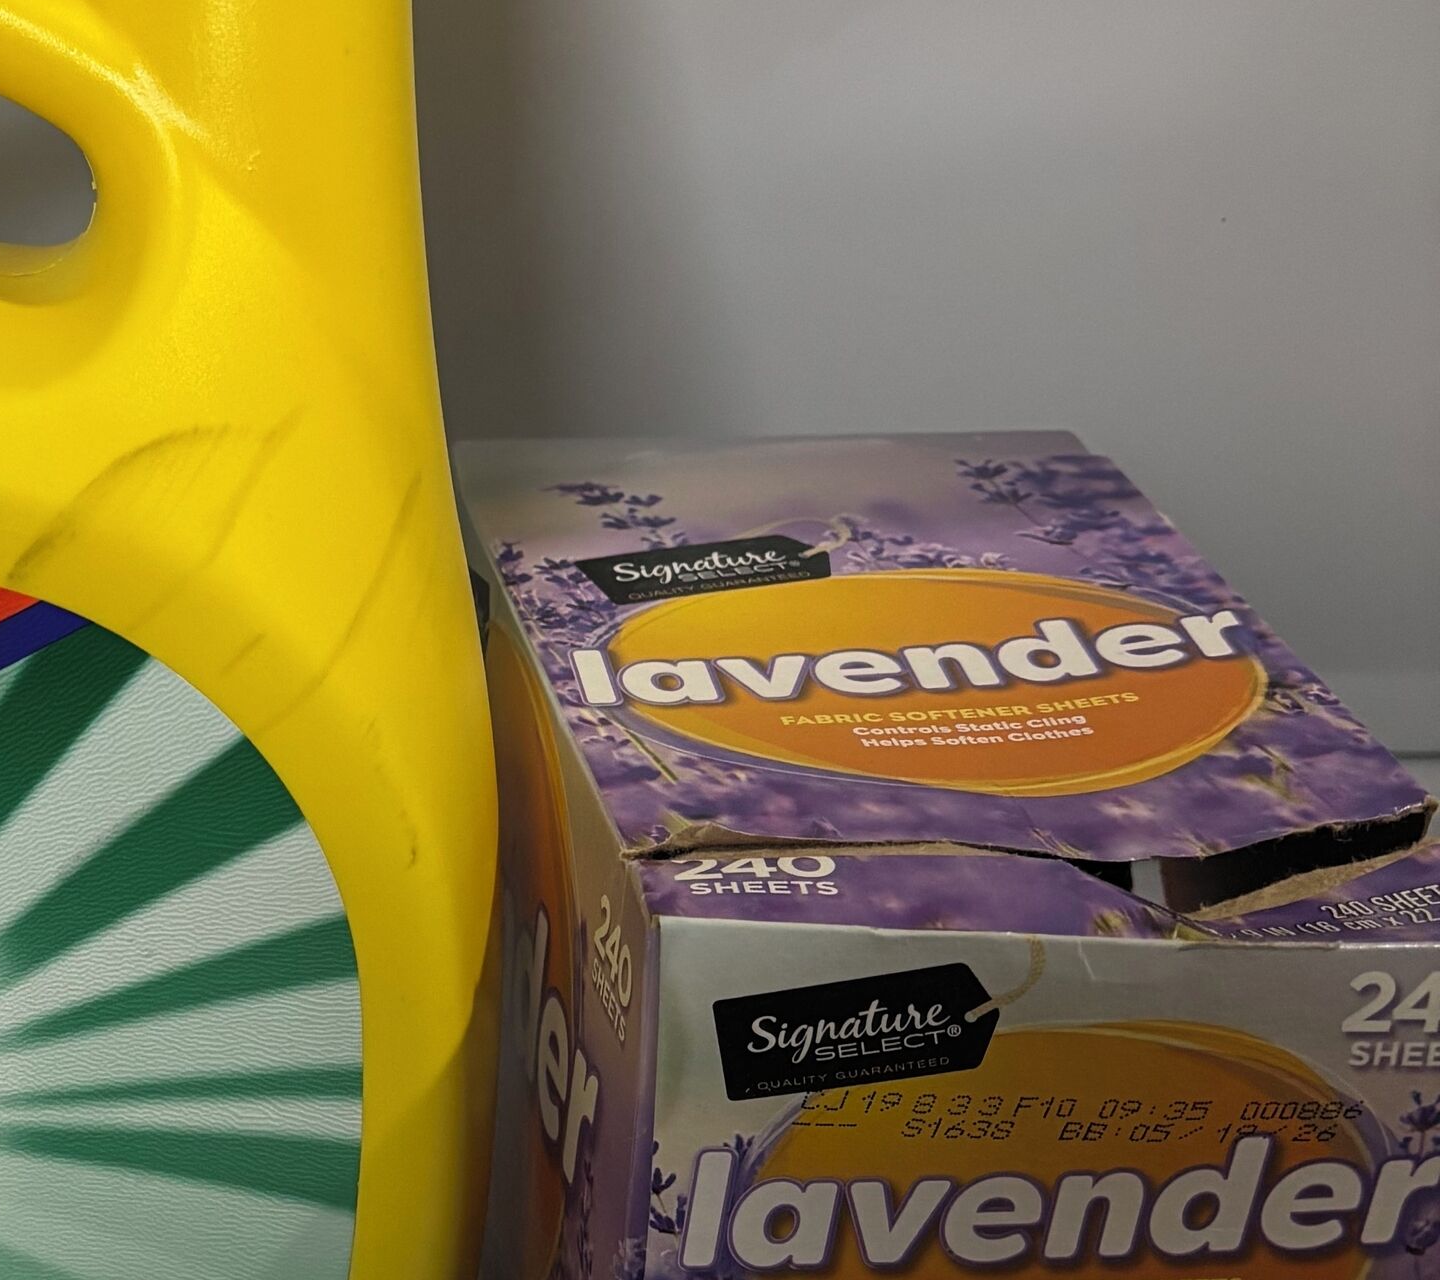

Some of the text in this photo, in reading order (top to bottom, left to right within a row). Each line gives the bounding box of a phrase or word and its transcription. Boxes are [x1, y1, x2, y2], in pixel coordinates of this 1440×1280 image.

[613, 549, 788, 583] Signature
[627, 585, 696, 601] QUALITY
[572, 607, 1248, 706] lavender
[780, 691, 1141, 727] FABRIC SOFTENER SHEETS
[852, 713, 1088, 737] Controls Static Cling
[860, 724, 1094, 749] Helps Soften Clothes
[670, 855, 837, 882] 240
[688, 880, 840, 896] SHEETS
[1320, 883, 1440, 920] 240 SHEET
[1342, 917, 1383, 932] cm
[593, 893, 633, 1008] 240
[590, 956, 627, 1044] SHEETS
[1340, 970, 1440, 1034] 24
[746, 998, 952, 1064] Signature
[756, 1055, 951, 1092] QUALITY GUARANTEED
[1097, 1097, 1214, 1121] 09:35
[1238, 1098, 1365, 1122] 000886
[680, 1135, 1440, 1269] lavender
